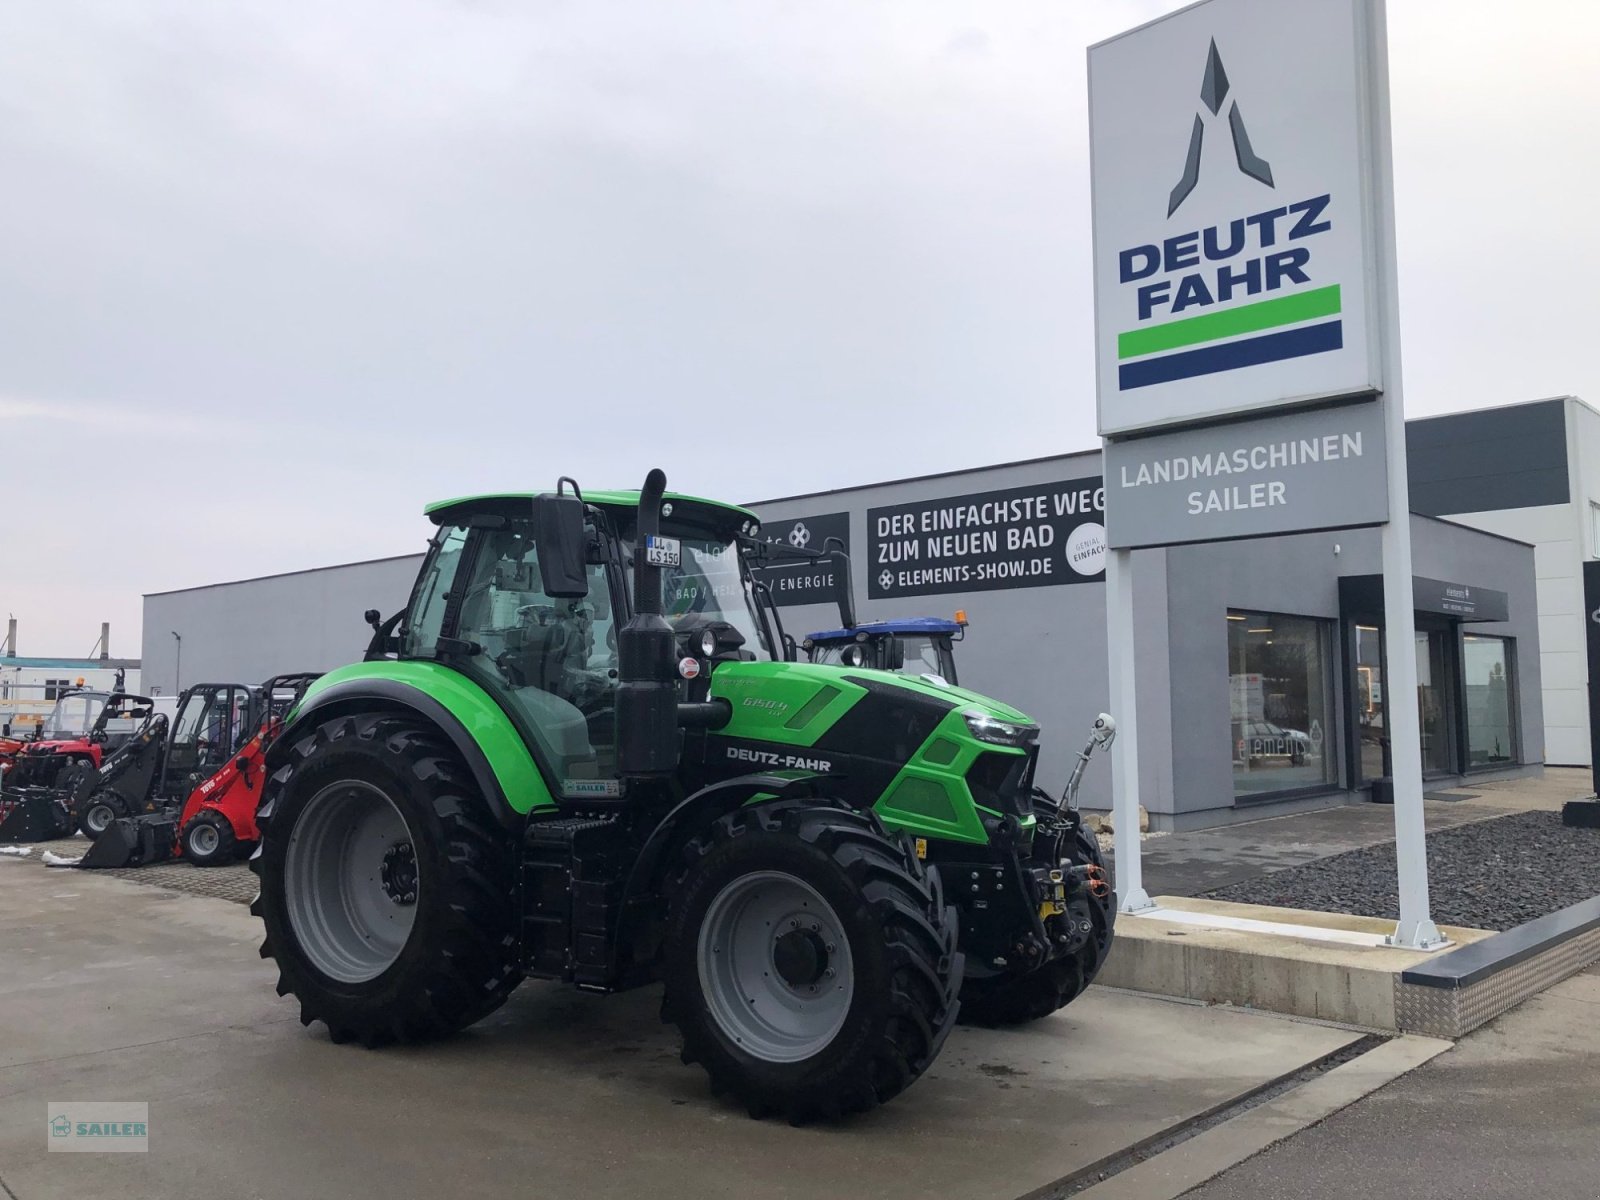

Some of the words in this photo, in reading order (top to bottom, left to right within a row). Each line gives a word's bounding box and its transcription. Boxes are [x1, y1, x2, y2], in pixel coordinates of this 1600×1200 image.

[1119, 193, 1331, 284] DEUTZ
[1137, 247, 1311, 320] FAHR
[1120, 432, 1363, 488] LANDMASCHINEN
[877, 513, 920, 537] DER
[921, 495, 1048, 533] EINFACHSTE
[1053, 488, 1105, 516] WEG
[1187, 481, 1287, 515] SAILER
[650, 550, 662, 562] LS
[663, 552, 678, 564] 150
[654, 537, 665, 550] LL
[878, 540, 920, 564] ZUM
[927, 531, 998, 559] NEUEN
[1007, 525, 1055, 551] BAD
[1075, 537, 1101, 552] GENIAL
[780, 574, 834, 591] ENERGIE
[898, 558, 1053, 587] ELEMENTS-SHOW.DE
[726, 746, 832, 772] DEUTZ-FAHR
